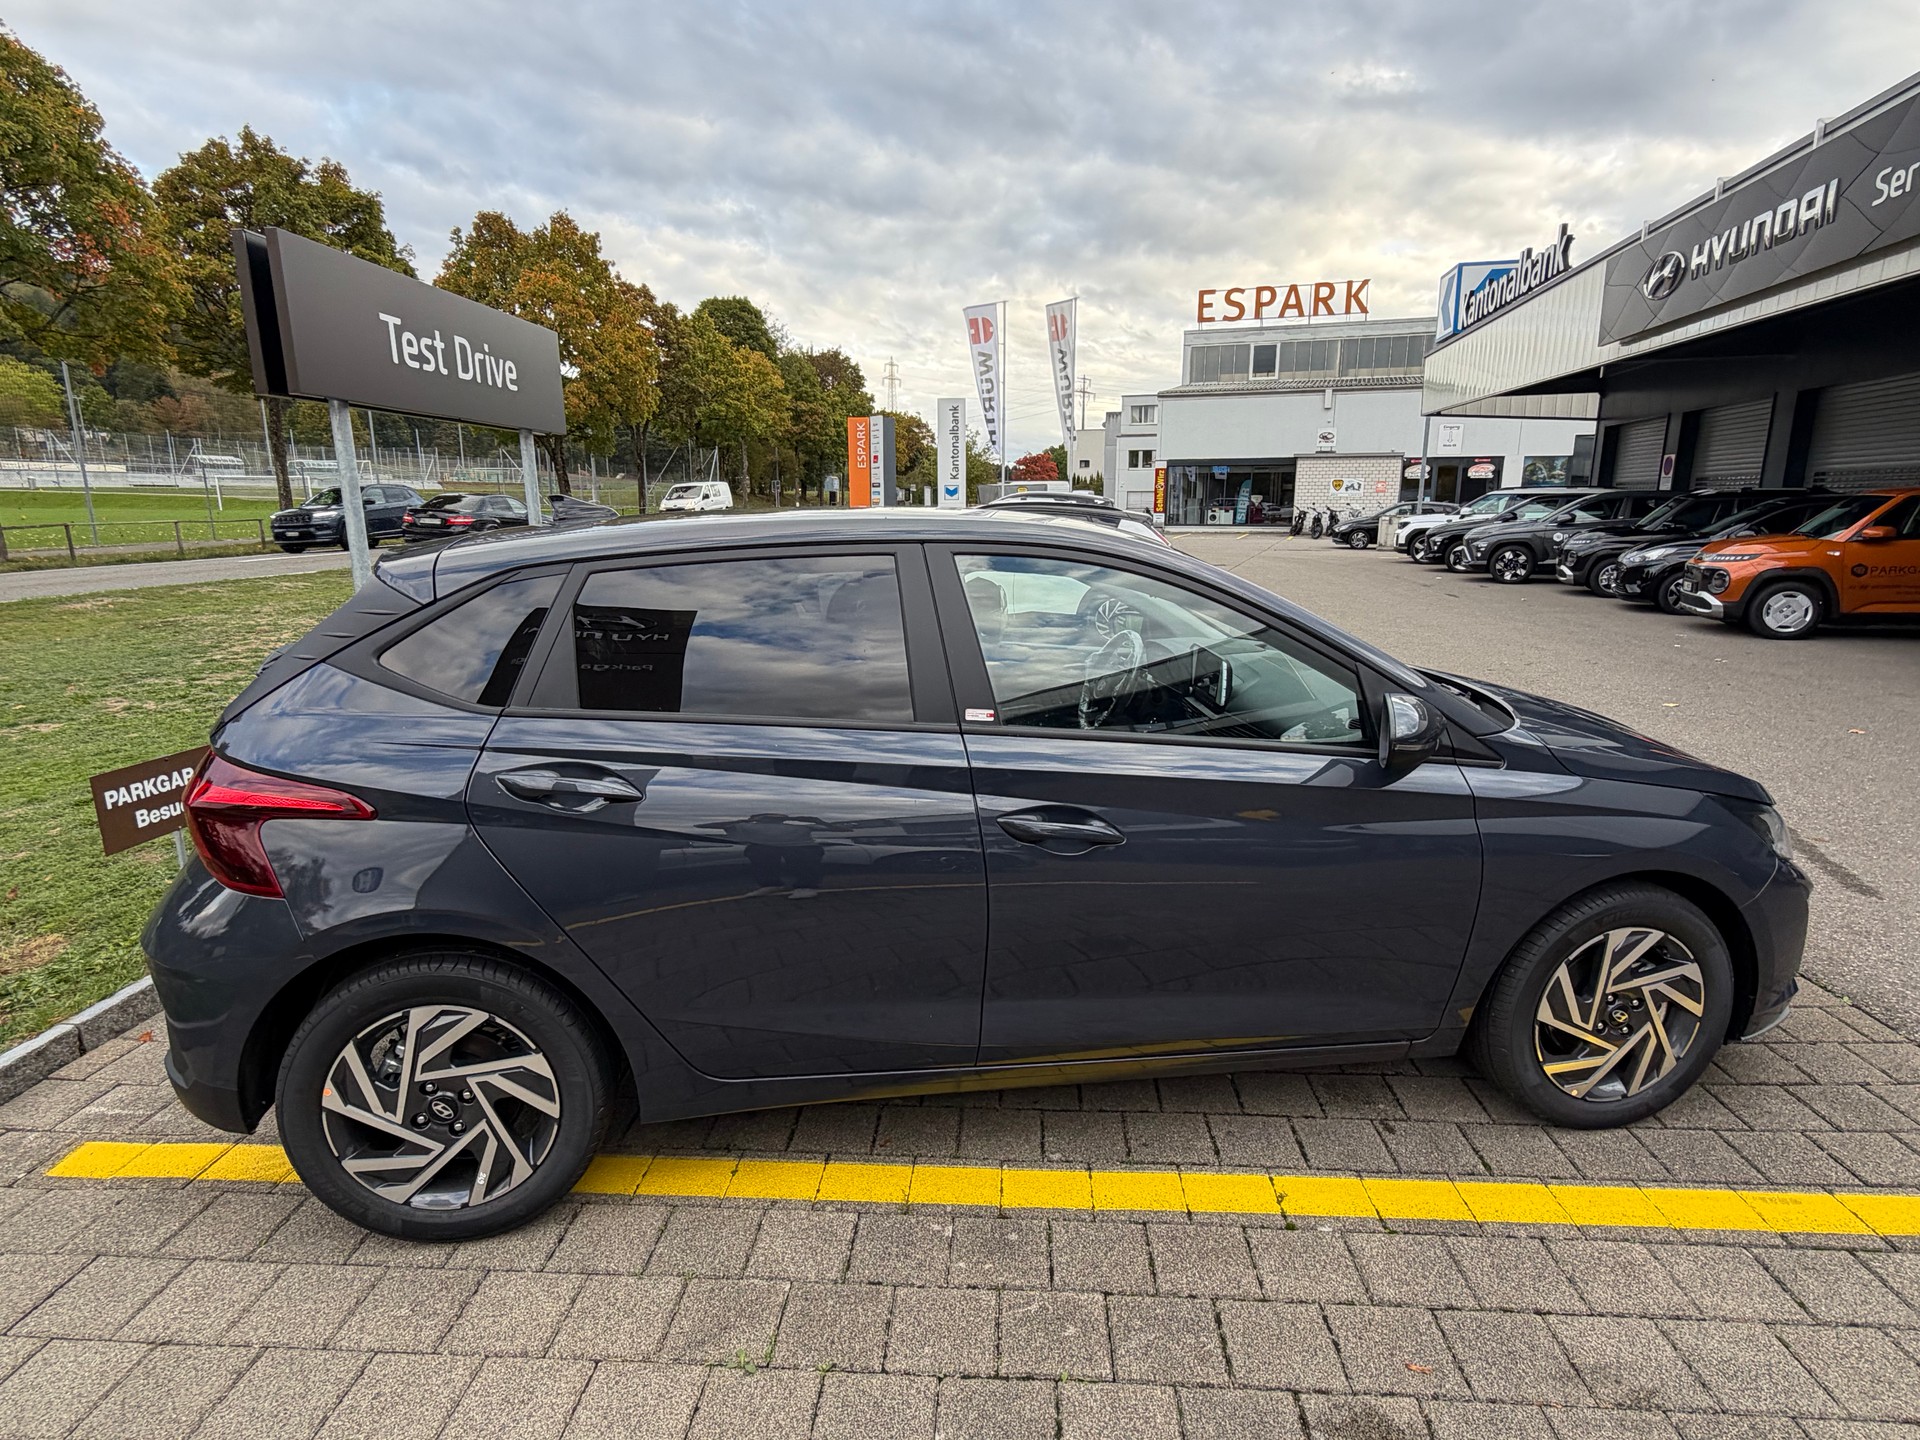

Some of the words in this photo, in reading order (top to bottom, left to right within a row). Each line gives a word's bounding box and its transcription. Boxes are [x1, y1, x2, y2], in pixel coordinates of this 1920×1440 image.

[1691, 178, 1839, 280] HYUNDAI
[1871, 161, 1920, 207] Ser
[1197, 279, 1371, 323] ESPARK
[1457, 223, 1575, 331] Kantonalbank
[378, 312, 448, 375] Test
[454, 335, 518, 391] Drive
[857, 422, 867, 468] ESPARK
[948, 405, 960, 480] Kantonalbank
[1870, 566, 1920, 575] PARKG
